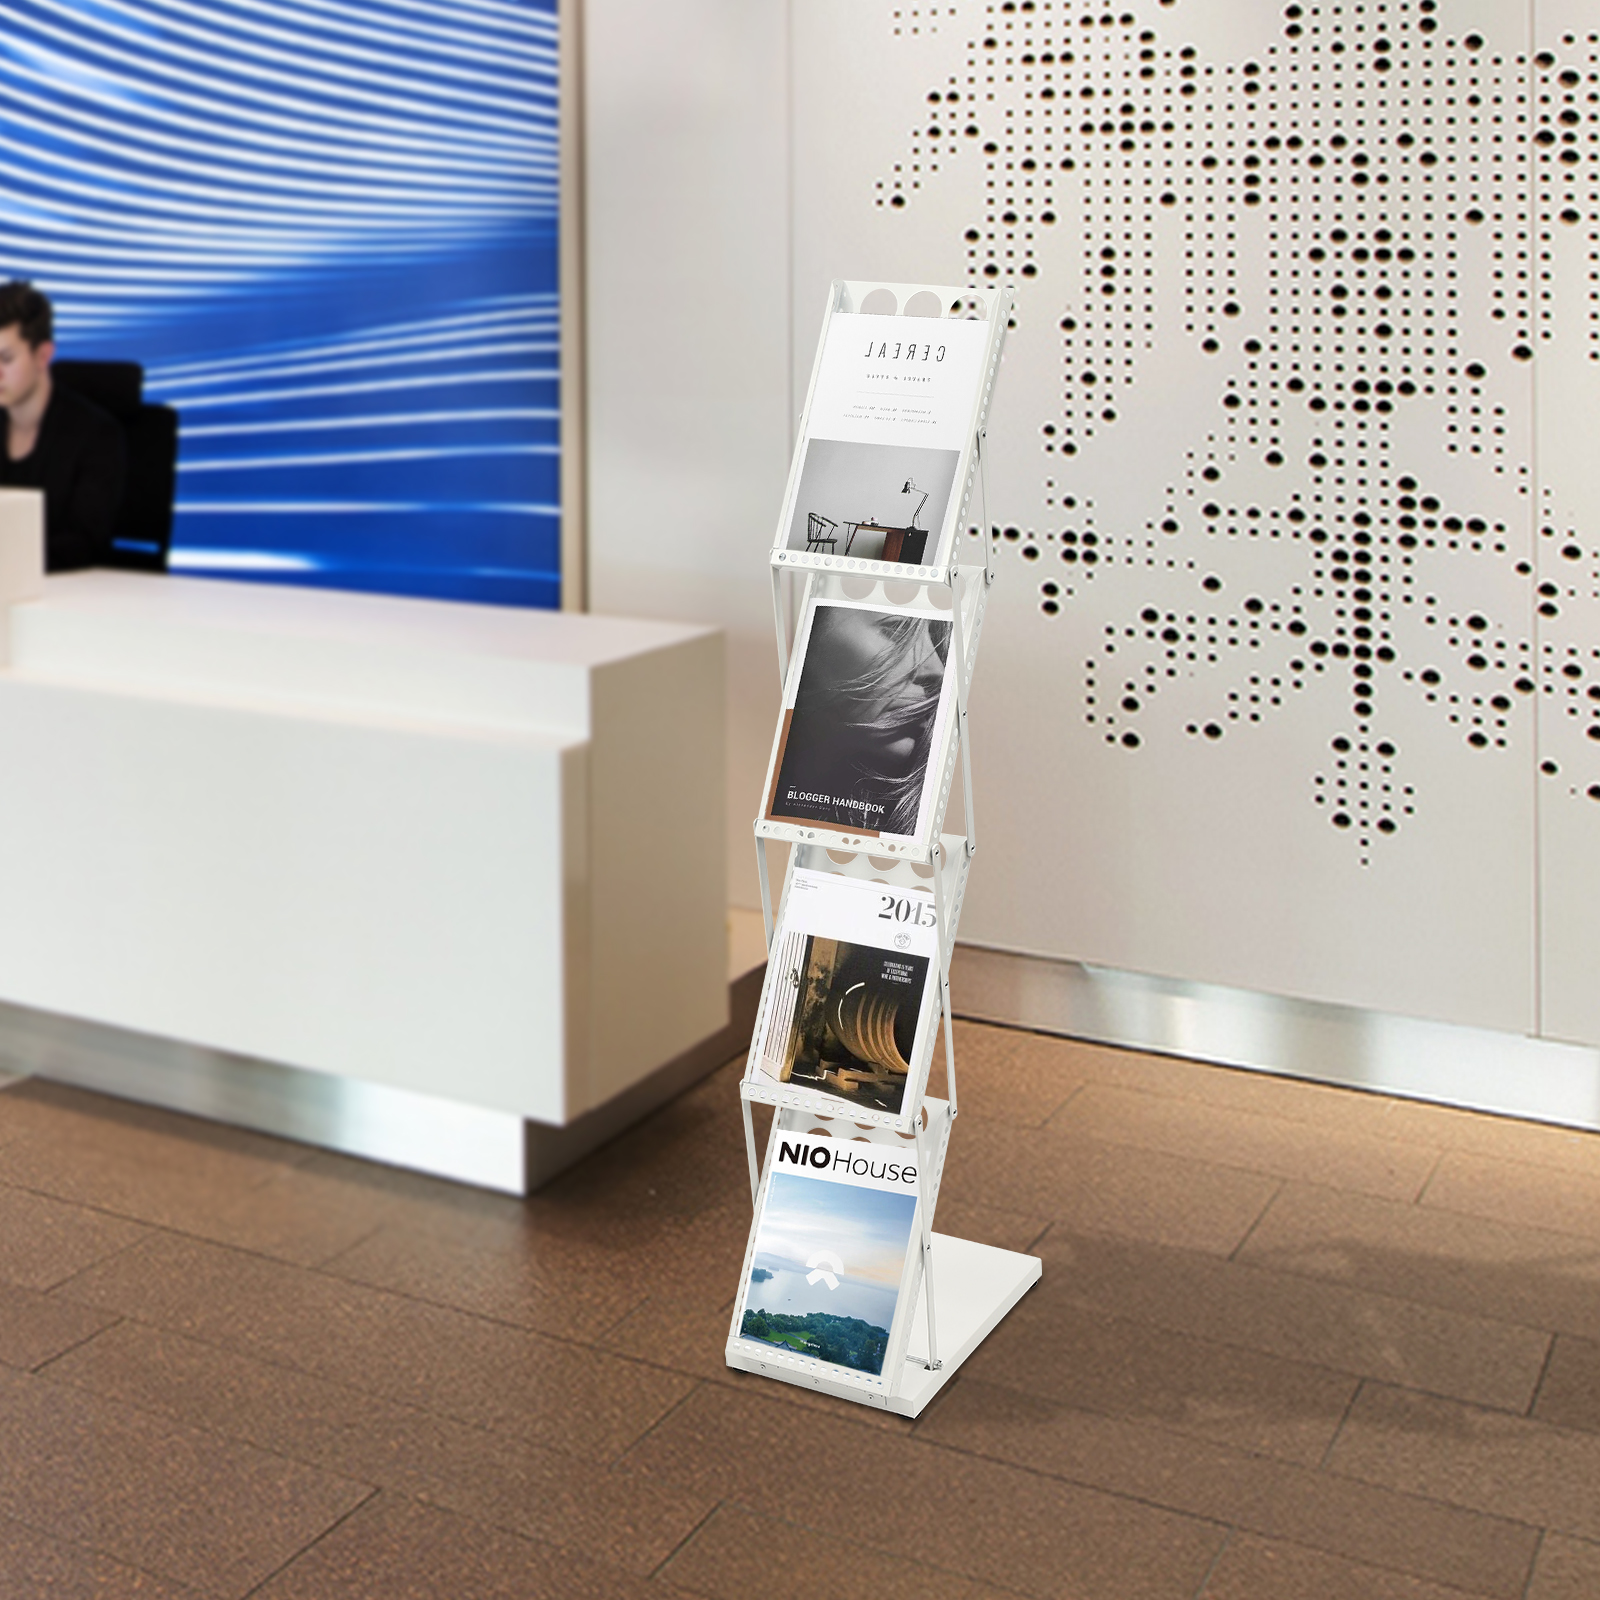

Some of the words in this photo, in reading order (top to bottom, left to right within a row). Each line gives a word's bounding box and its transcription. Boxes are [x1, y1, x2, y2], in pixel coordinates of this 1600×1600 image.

[787, 790, 831, 804] BLOGGER
[832, 796, 885, 814] HANDBOOK
[878, 895, 937, 928] 2015
